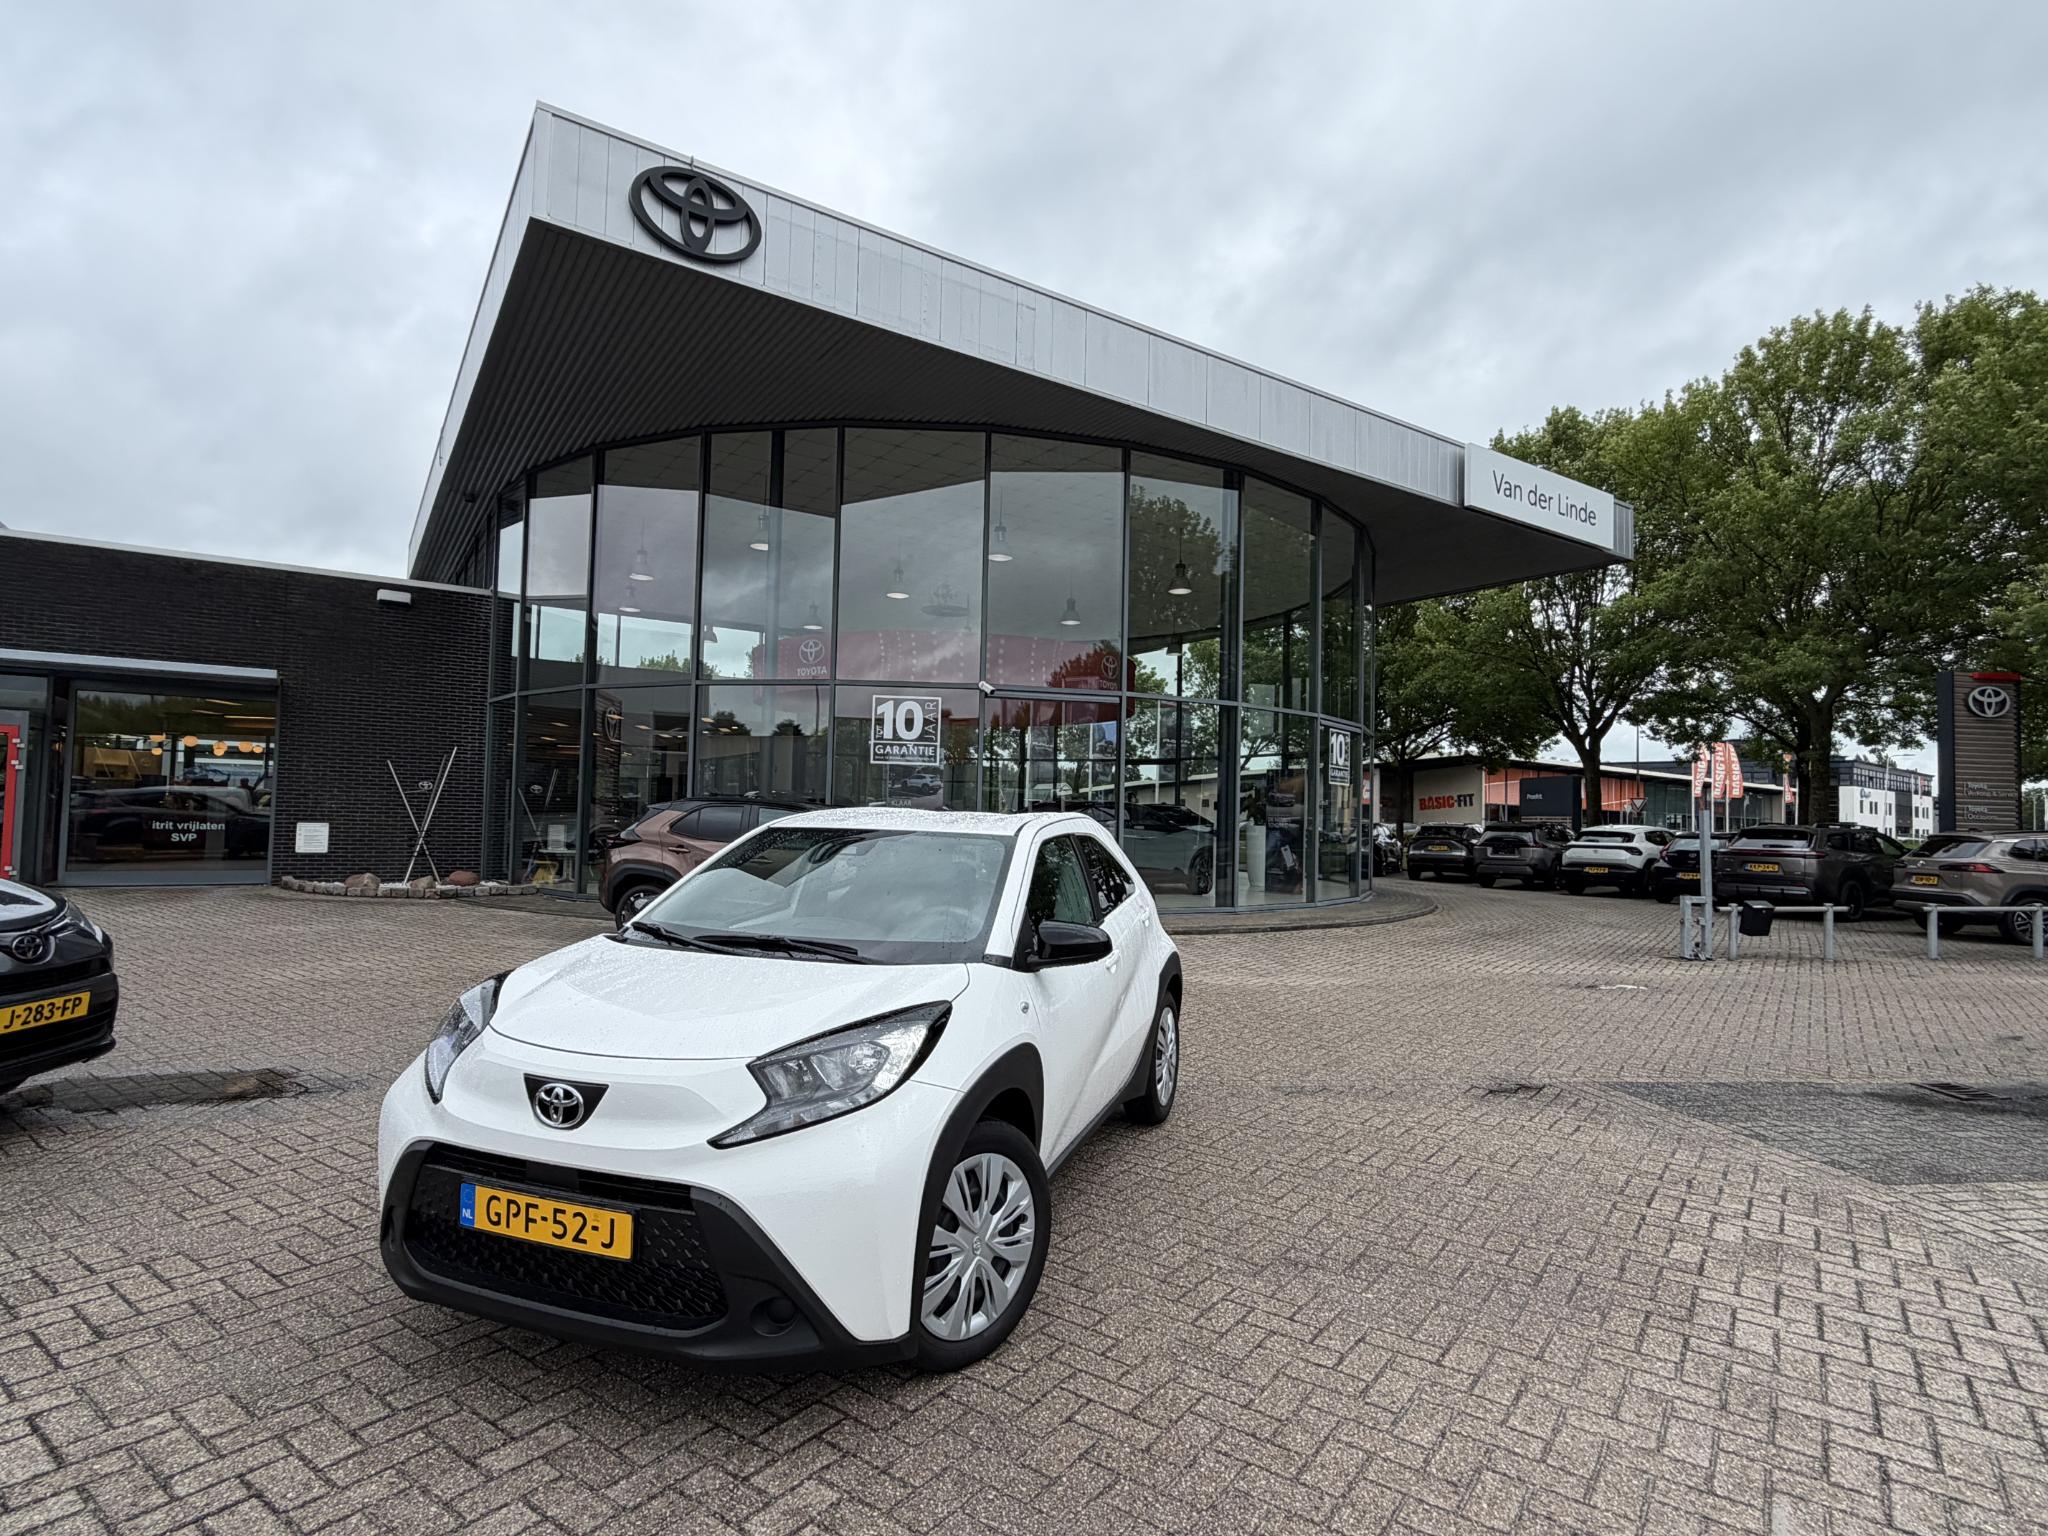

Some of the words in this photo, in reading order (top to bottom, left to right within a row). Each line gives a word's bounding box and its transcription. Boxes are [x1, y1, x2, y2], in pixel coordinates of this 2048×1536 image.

[1493, 470, 1523, 501] Van
[1527, 484, 1554, 512] der
[1557, 493, 1597, 526] Linde
[797, 666, 827, 676] TOYOTA
[876, 700, 924, 740] 10
[925, 702, 937, 741] JAAR
[875, 744, 936, 756] GARANTIE
[1331, 733, 1346, 766] 10
[1419, 793, 1475, 811] BASIC-FIT
[170, 832, 198, 842] SVP
[176, 820, 226, 831] vrijlaten
[4, 997, 82, 1030] J-283-FP
[462, 1208, 473, 1219] NL
[485, 1195, 615, 1249] GPF-52-J
